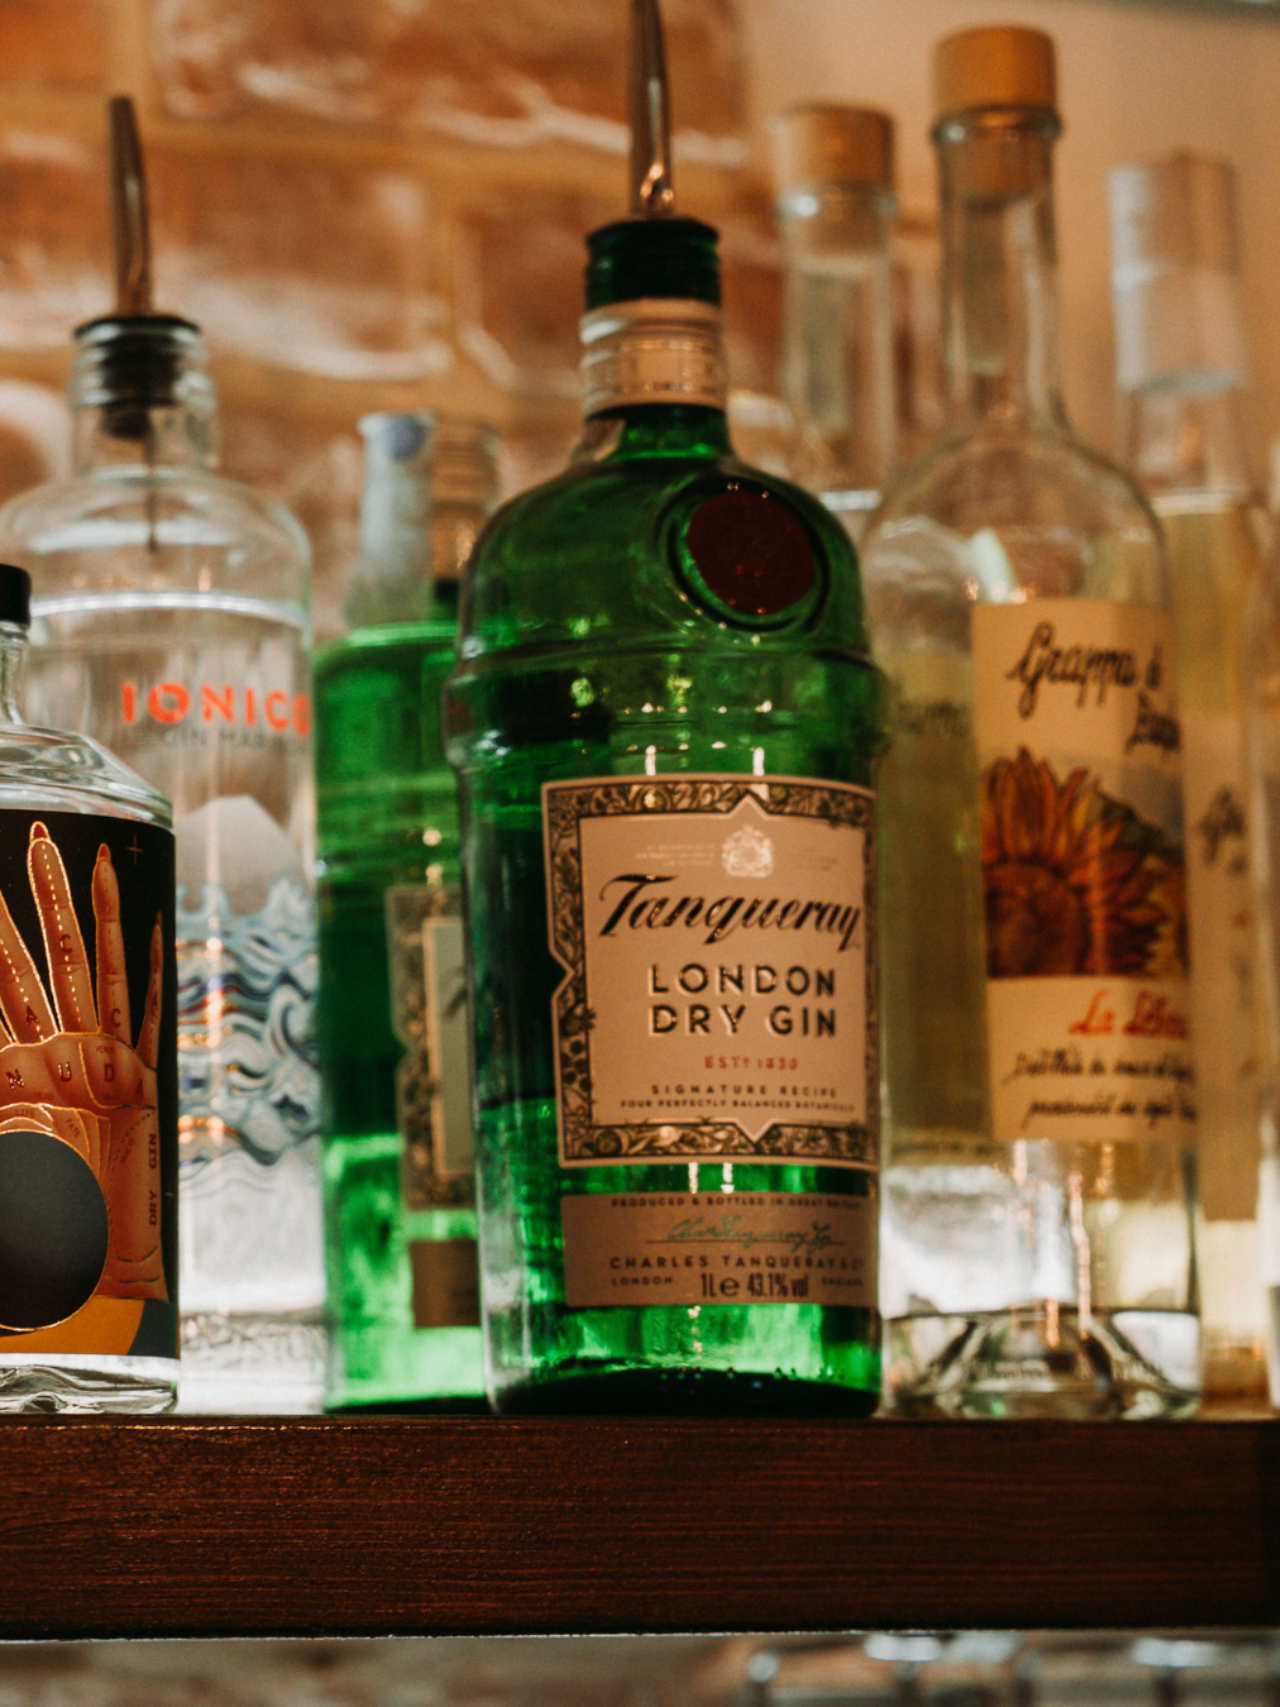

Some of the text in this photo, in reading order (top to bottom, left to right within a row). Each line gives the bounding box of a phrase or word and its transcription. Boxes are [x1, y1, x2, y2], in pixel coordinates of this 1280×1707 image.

[599, 874, 860, 952] Tanqueray
[650, 963, 835, 997] LONDON
[652, 1004, 835, 1037] DRY GIN
[651, 1084, 835, 1098] SIGNATURE RECIPE
[658, 1099, 726, 1108] PERFECTLY
[148, 1133, 157, 1226] DRY GIN
[611, 1197, 685, 1207] PRODUCED
[707, 1196, 764, 1206] BOTTLED
[610, 1255, 708, 1270] CHARLES
[722, 1255, 834, 1269] TANQUERAY
[611, 1276, 673, 1287] LONDON
